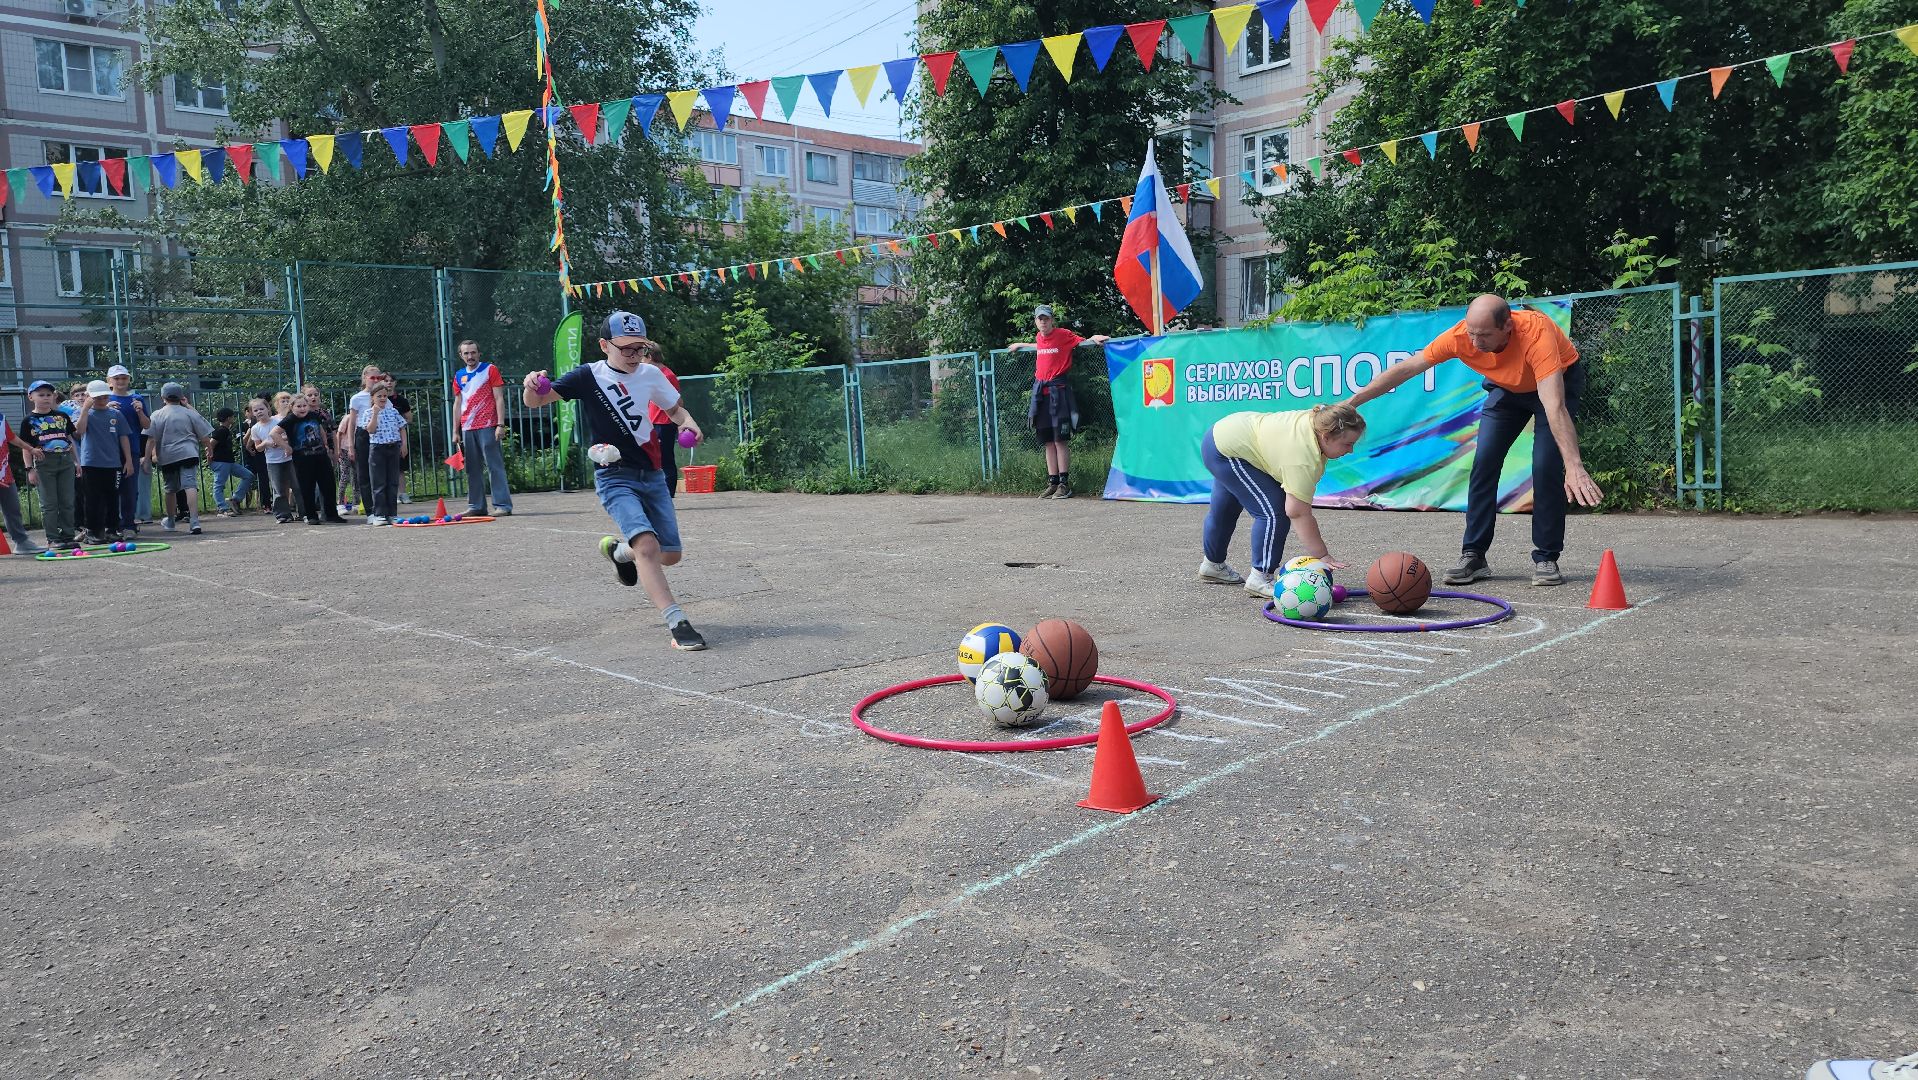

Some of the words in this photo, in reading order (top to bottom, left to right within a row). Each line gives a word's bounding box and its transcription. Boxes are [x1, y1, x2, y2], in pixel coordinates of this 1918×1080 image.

[1185, 358, 1284, 383] СЕРПУХОВ
[1187, 381, 1284, 403] ВЫБИРАЕТ
[607, 381, 642, 431] FILA
